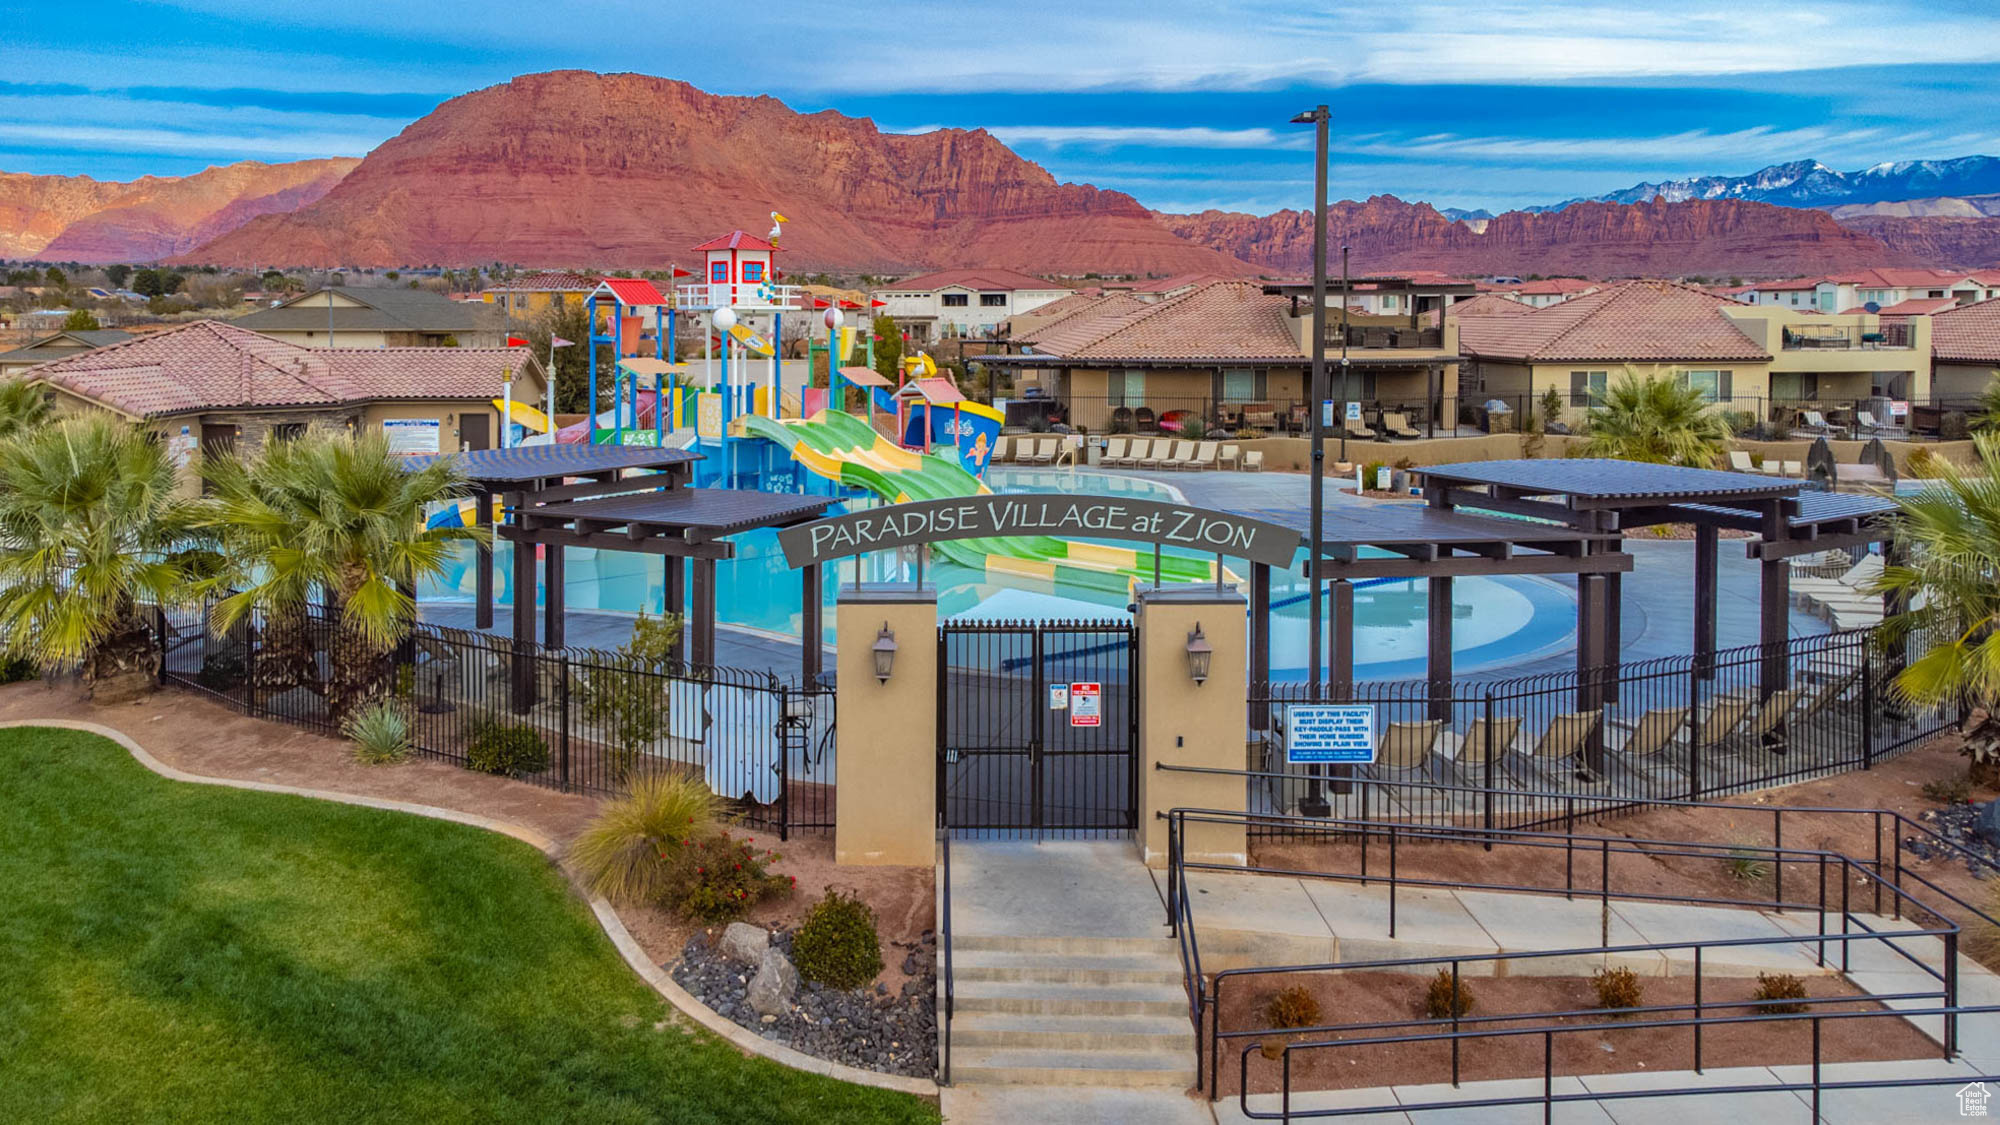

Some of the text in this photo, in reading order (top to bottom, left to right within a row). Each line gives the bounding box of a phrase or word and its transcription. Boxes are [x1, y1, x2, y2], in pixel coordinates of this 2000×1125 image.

[809, 501, 1256, 558] PARADISE VILLAGE at ZION
